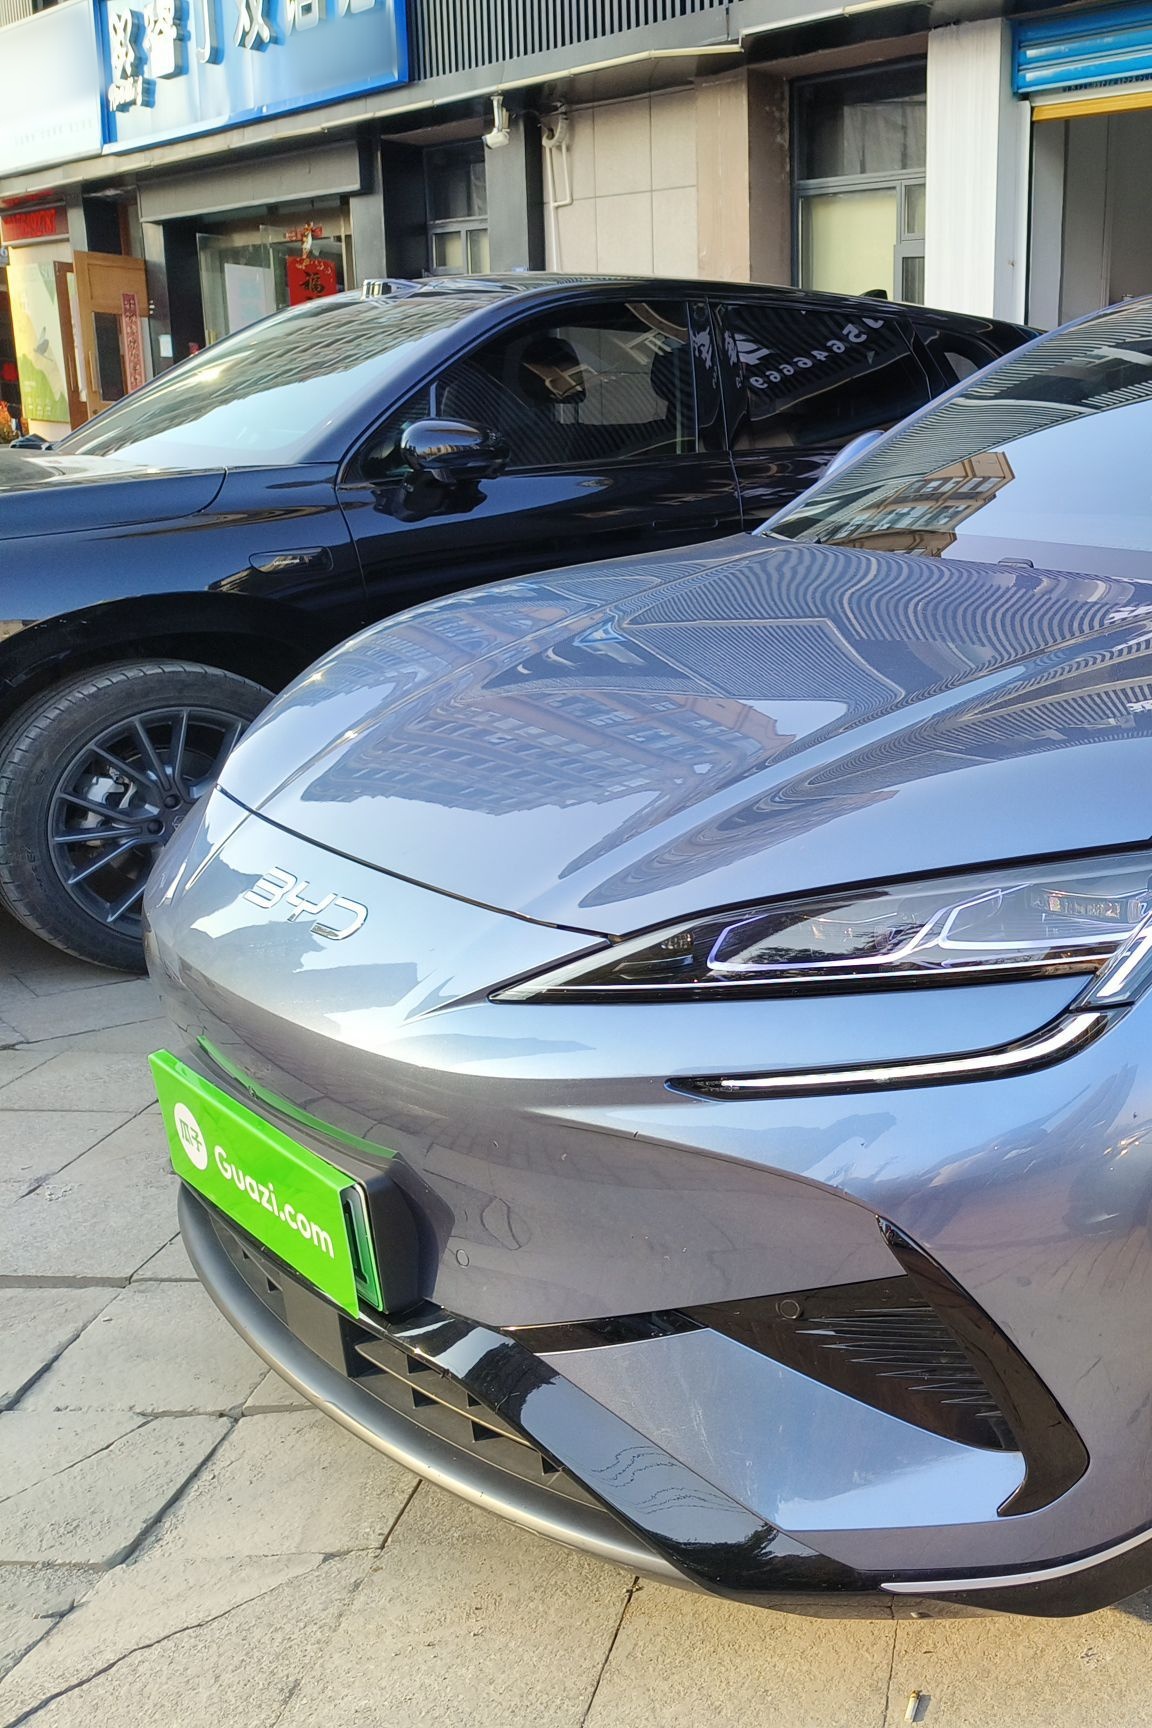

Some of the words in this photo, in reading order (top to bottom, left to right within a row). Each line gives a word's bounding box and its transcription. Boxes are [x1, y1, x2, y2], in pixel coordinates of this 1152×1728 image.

[299, 271, 325, 293] 福
[243, 866, 368, 940] BYD
[214, 1144, 335, 1259] Guazi.com
